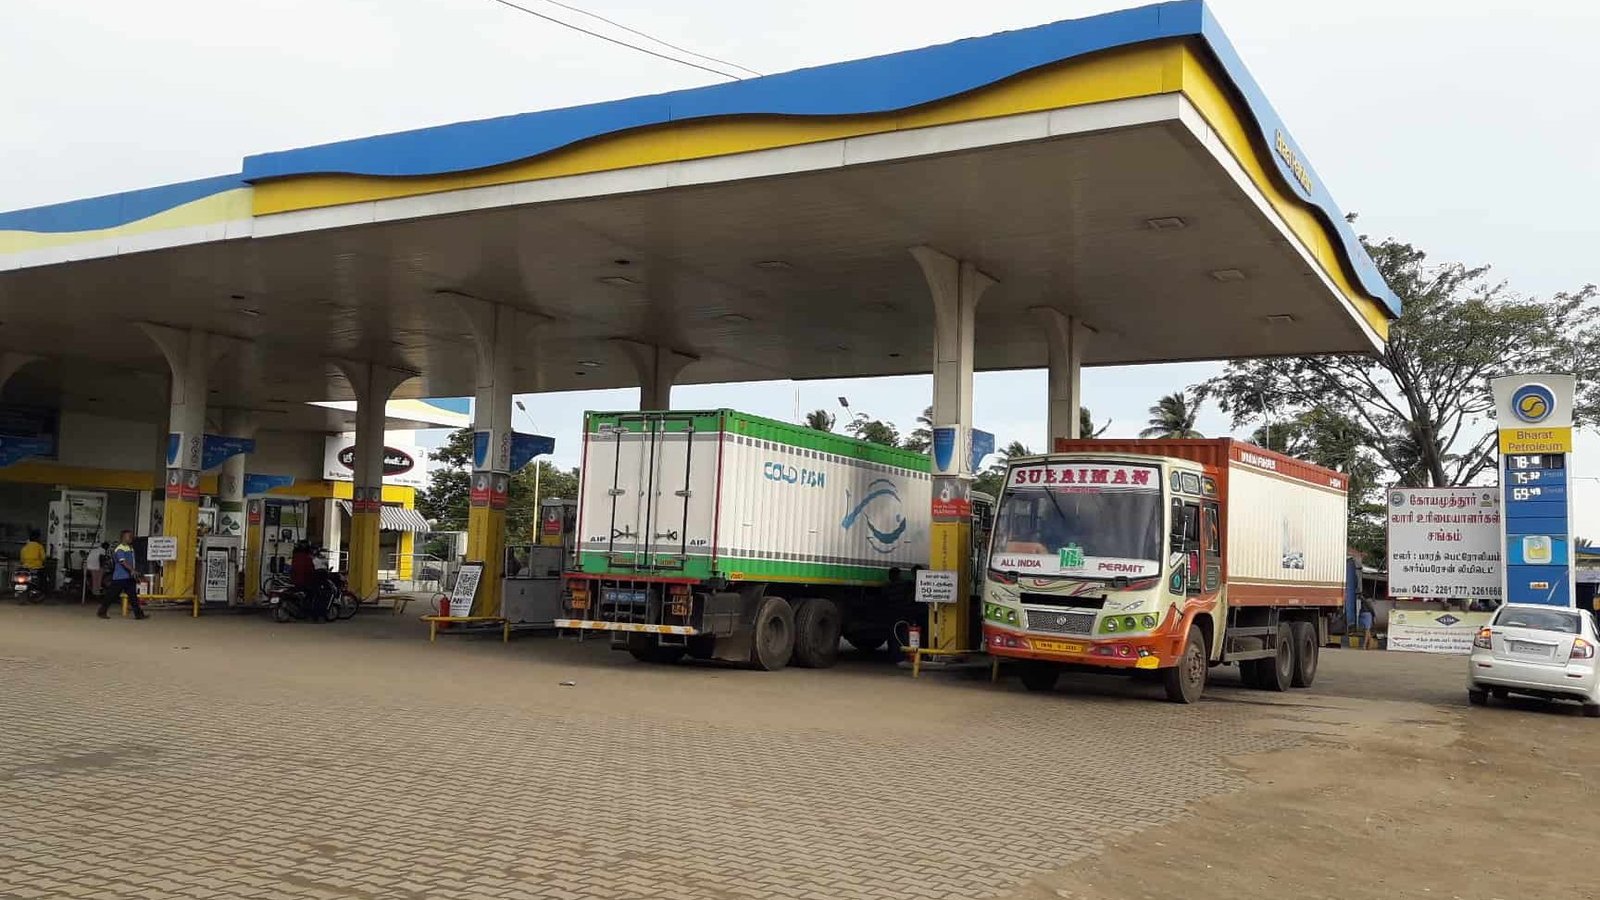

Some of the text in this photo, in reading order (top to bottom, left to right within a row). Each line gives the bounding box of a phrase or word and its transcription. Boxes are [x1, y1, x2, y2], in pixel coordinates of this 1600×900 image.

[1516, 431, 1554, 440] Bharat
[1508, 443, 1562, 451] Petroleum
[764, 461, 825, 488] COLD FISH
[1391, 510, 1414, 524] லாரி
[1427, 528, 1462, 541] சங்கம்
[1098, 562, 1145, 573] PERMIT
[1412, 585, 1429, 594] 0422
